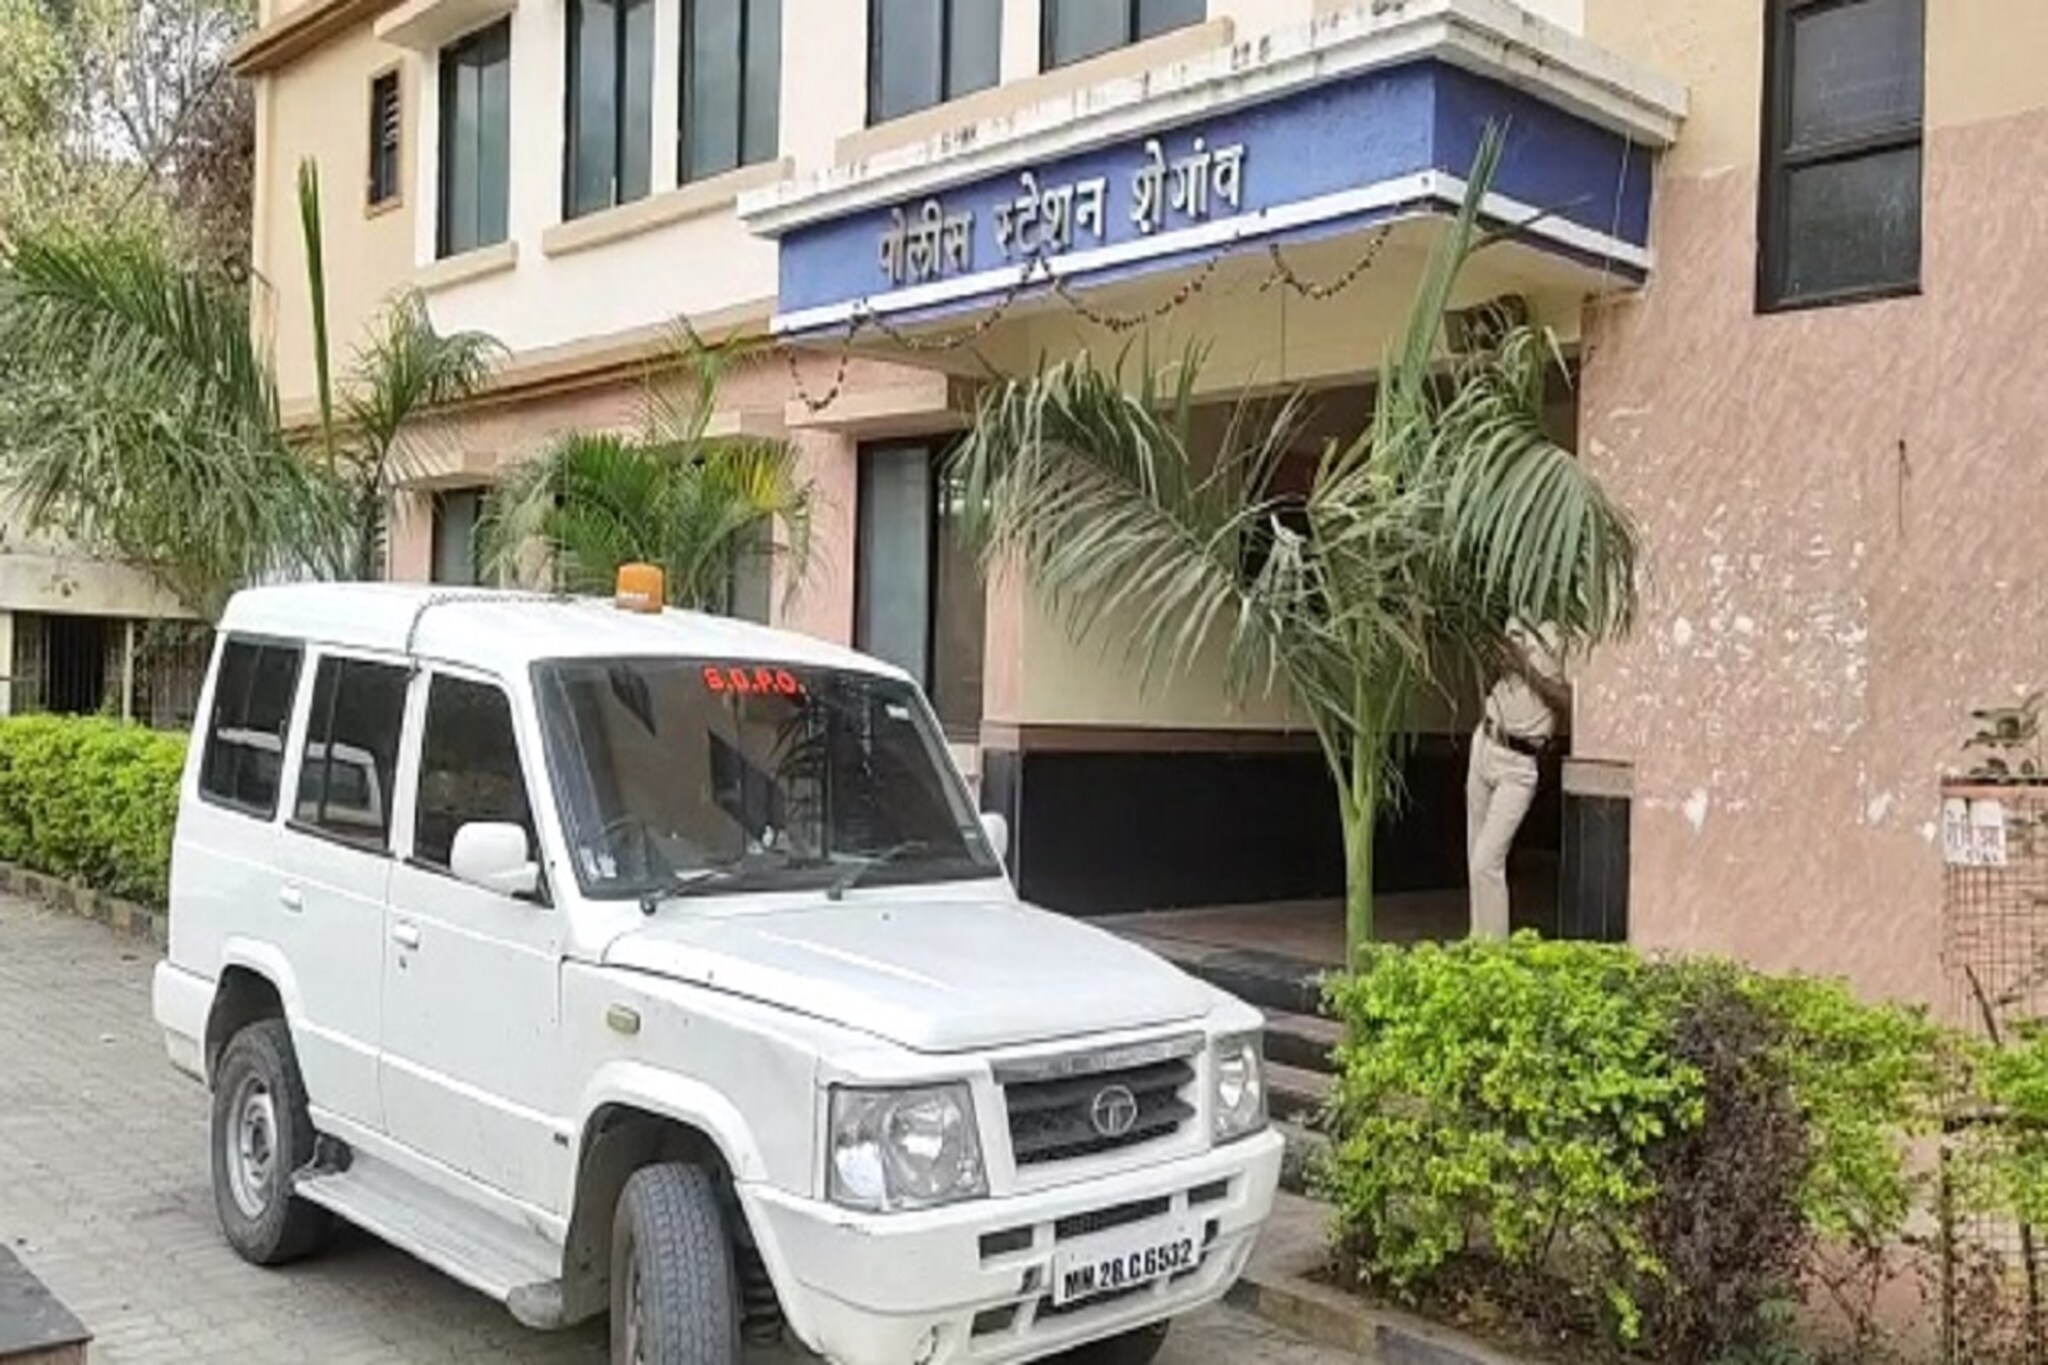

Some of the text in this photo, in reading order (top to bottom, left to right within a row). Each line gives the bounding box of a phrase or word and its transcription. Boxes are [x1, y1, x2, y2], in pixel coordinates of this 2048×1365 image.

[879, 138, 1244, 284] पोलीस स्टेशन शेगांव
